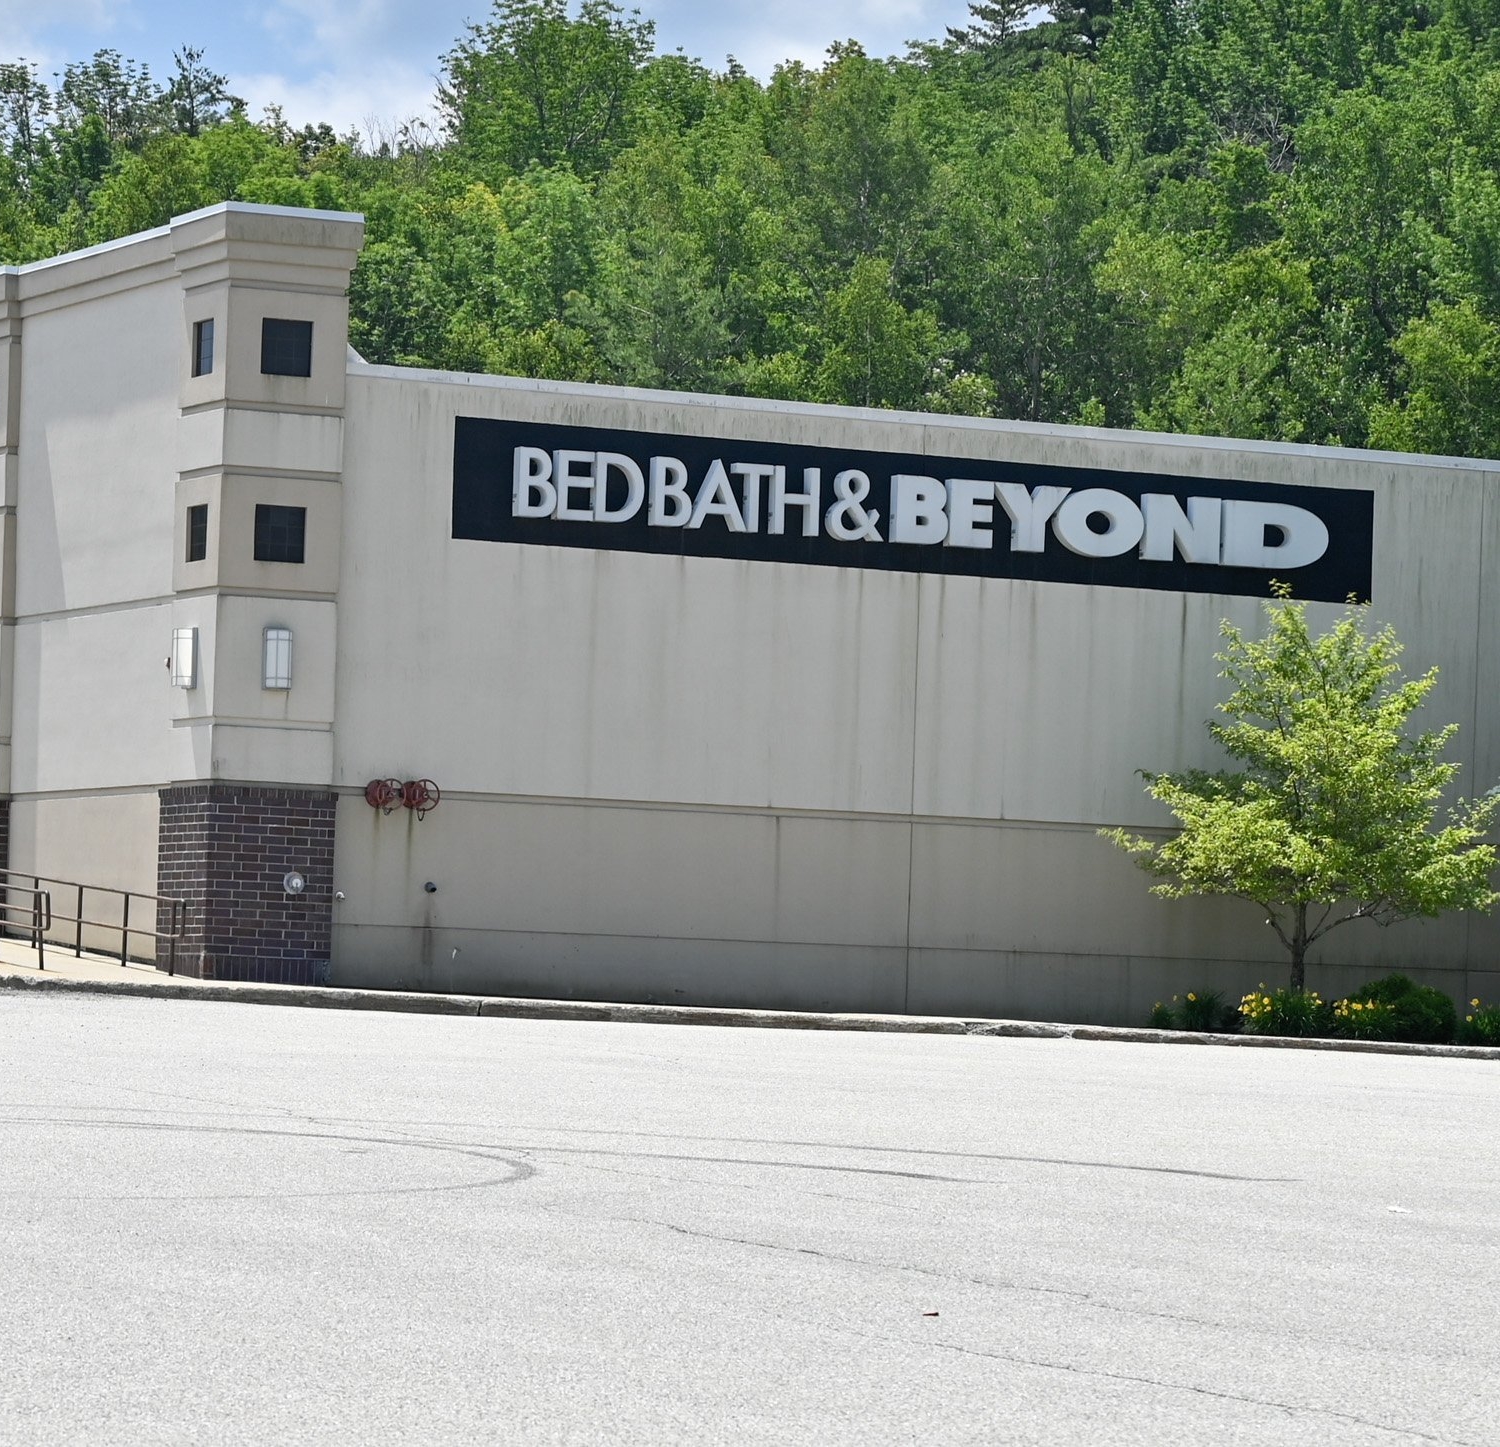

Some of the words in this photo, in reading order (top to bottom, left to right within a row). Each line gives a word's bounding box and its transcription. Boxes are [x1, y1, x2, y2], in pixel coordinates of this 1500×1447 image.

[512, 446, 645, 523] BED
[647, 456, 821, 537] BATH
[825, 469, 884, 542] &
[888, 474, 1330, 570] BEYOND
